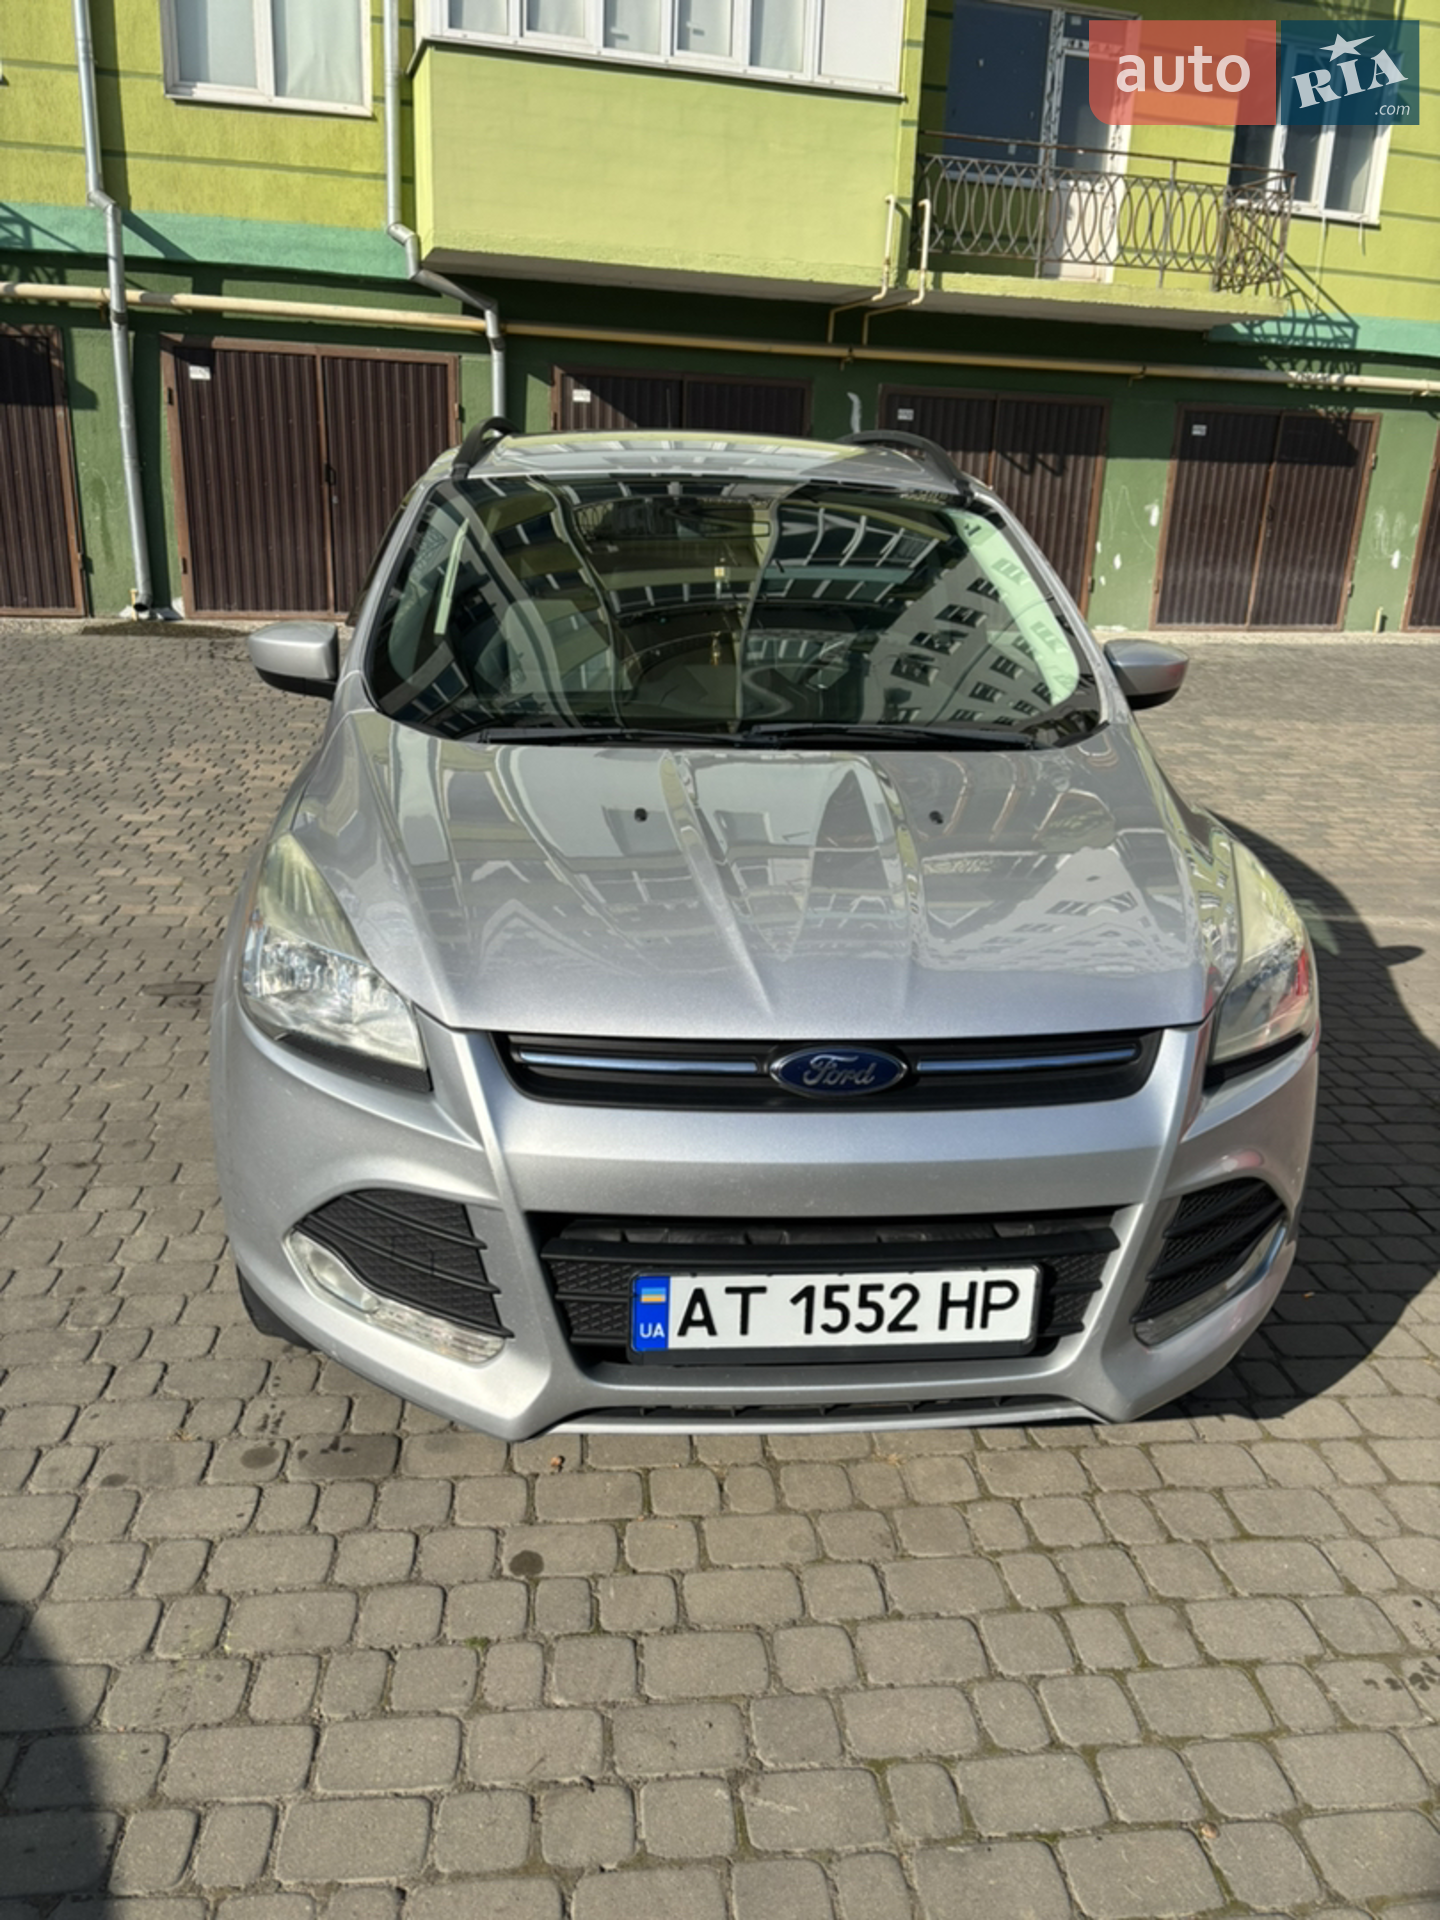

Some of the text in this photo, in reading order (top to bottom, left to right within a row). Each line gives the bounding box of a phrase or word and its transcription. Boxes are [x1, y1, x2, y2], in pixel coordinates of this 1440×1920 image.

[802, 1054, 878, 1086] Ford
[676, 1280, 1020, 1337] AT 1552 HP
[639, 1323, 665, 1338] UA
